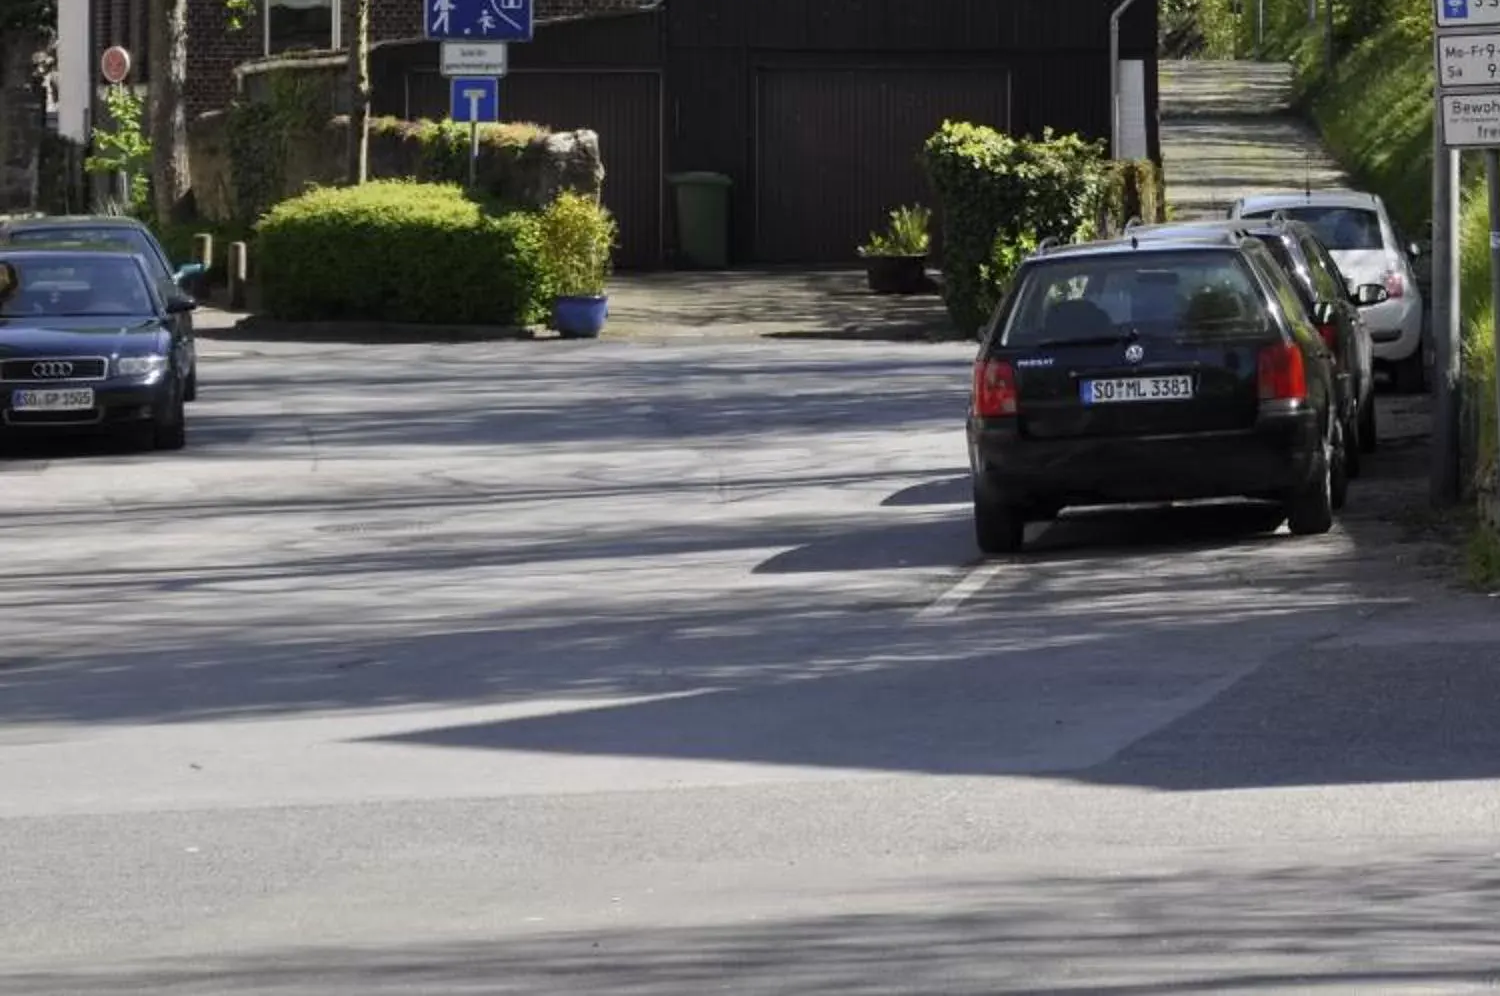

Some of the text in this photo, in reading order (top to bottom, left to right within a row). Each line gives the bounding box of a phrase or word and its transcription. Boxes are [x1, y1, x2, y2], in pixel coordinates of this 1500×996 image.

[1447, 65, 1464, 79] Sa
[1094, 381, 1115, 399] SO
[1151, 378, 1190, 397] 3381
